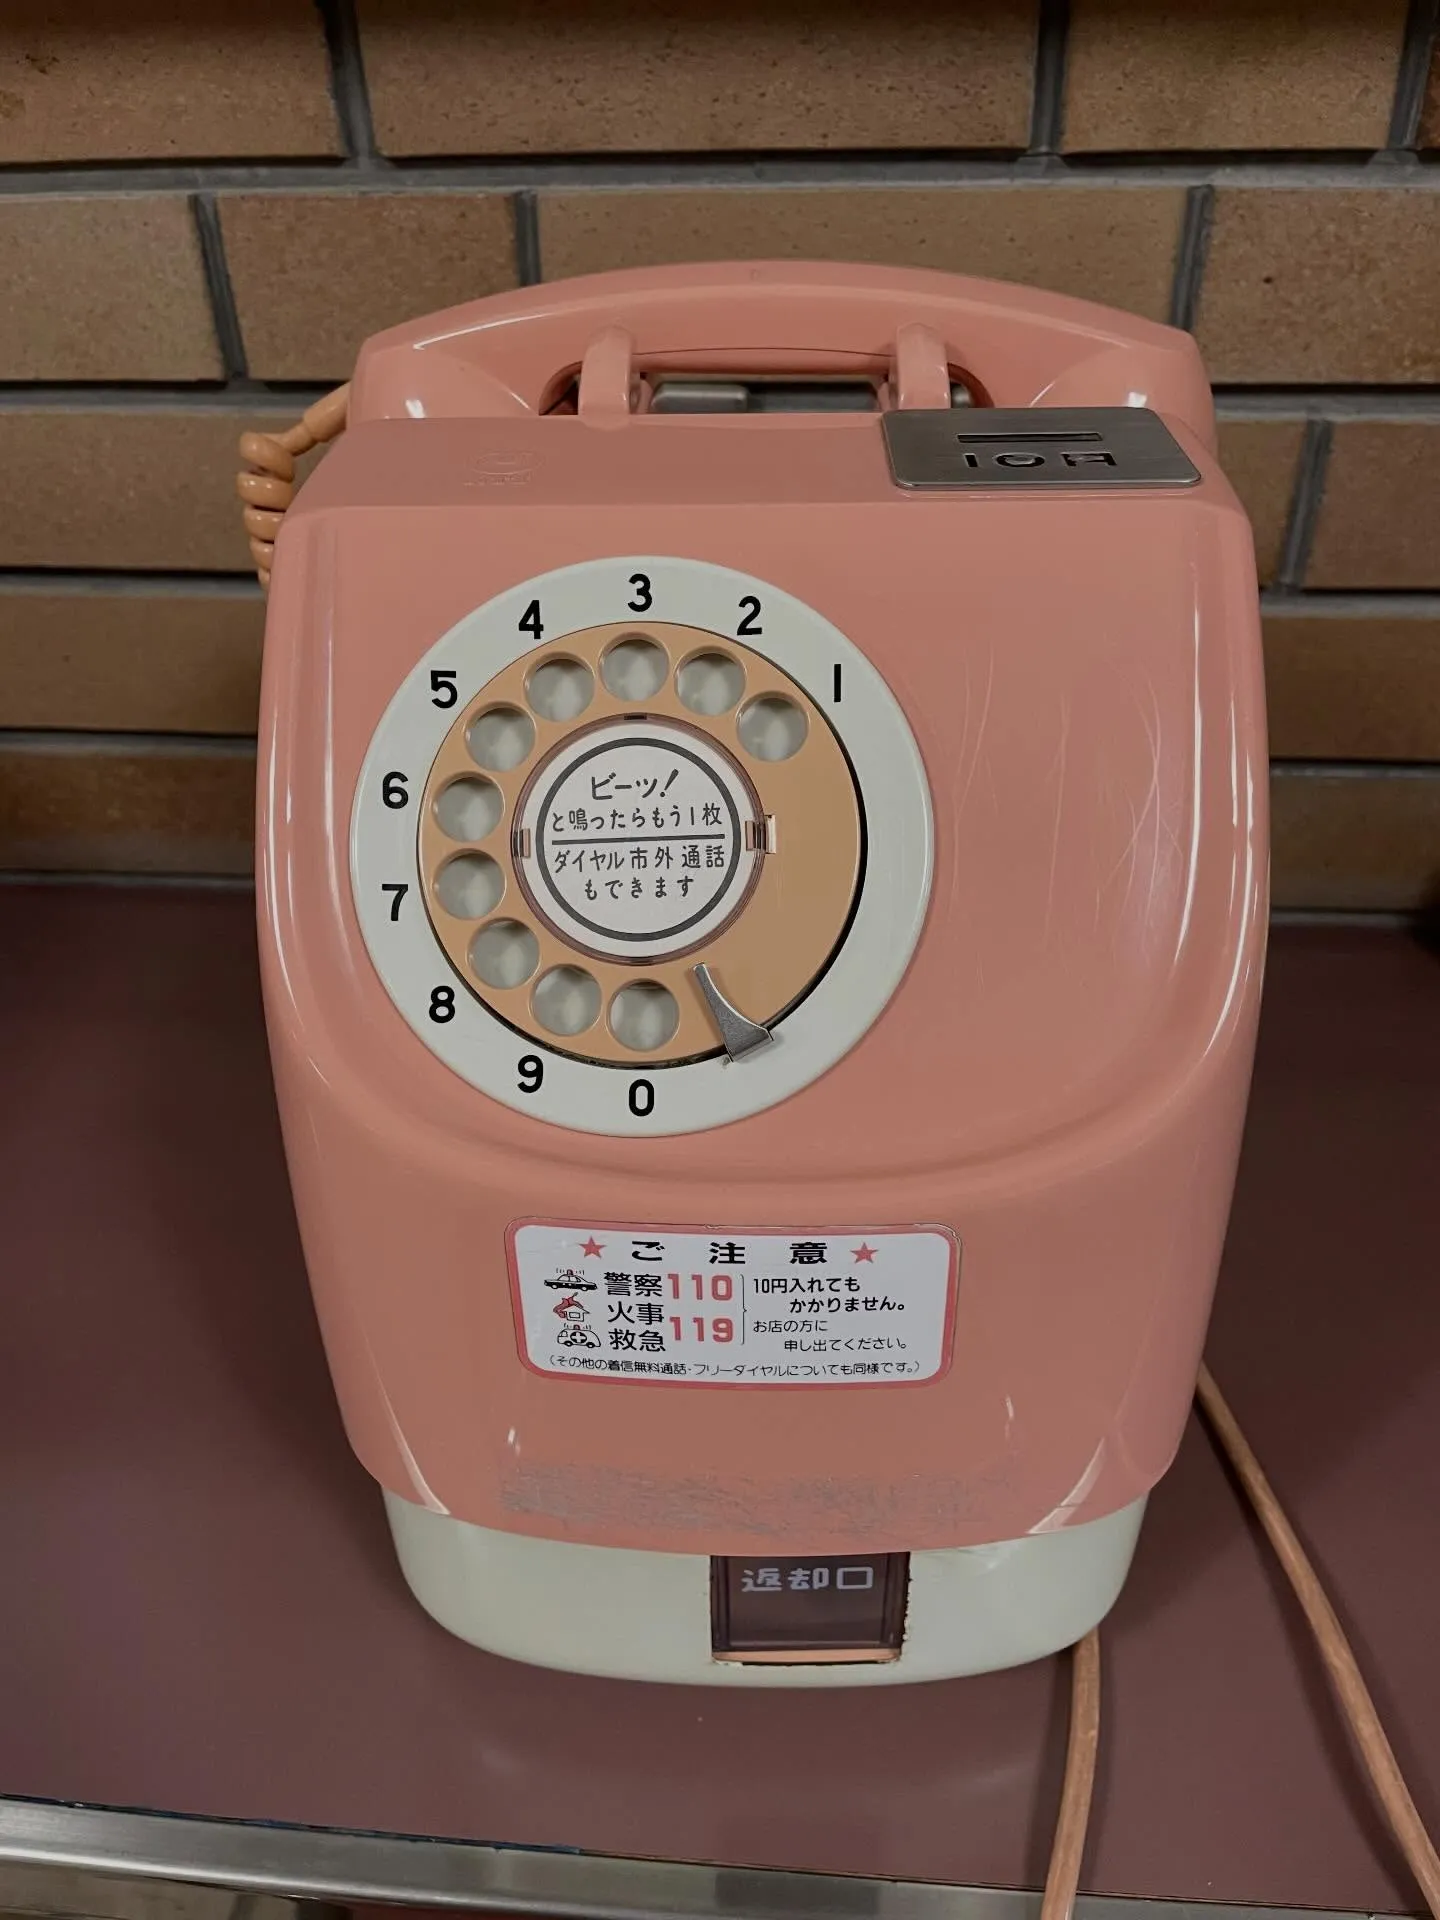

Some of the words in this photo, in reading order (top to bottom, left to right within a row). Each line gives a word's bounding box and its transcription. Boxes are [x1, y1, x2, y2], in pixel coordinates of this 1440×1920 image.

[627, 573, 653, 613] 3
[518, 599, 544, 640] 4
[736, 595, 763, 636] 2
[430, 669, 458, 708] 5
[833, 663, 842, 703] 1
[382, 771, 409, 810] 6
[552, 802, 723, 832] と鳴ったらもう1枚
[381, 883, 409, 922] 7
[584, 875, 694, 901] もできます
[428, 985, 456, 1024] 8
[517, 1054, 544, 1094] 9
[628, 1078, 655, 1117] 0
[603, 1271, 663, 1297] 警察
[667, 1273, 733, 1301] 110
[752, 1276, 861, 1294] 10円入れても
[607, 1300, 665, 1326] 火事
[789, 1296, 906, 1314] かかりません。
[608, 1327, 667, 1353] 救急
[669, 1316, 734, 1343] 119
[752, 1319, 829, 1334] お店の方に
[783, 1337, 907, 1353] 申し出てください。
[741, 1566, 873, 1593] 返却口
